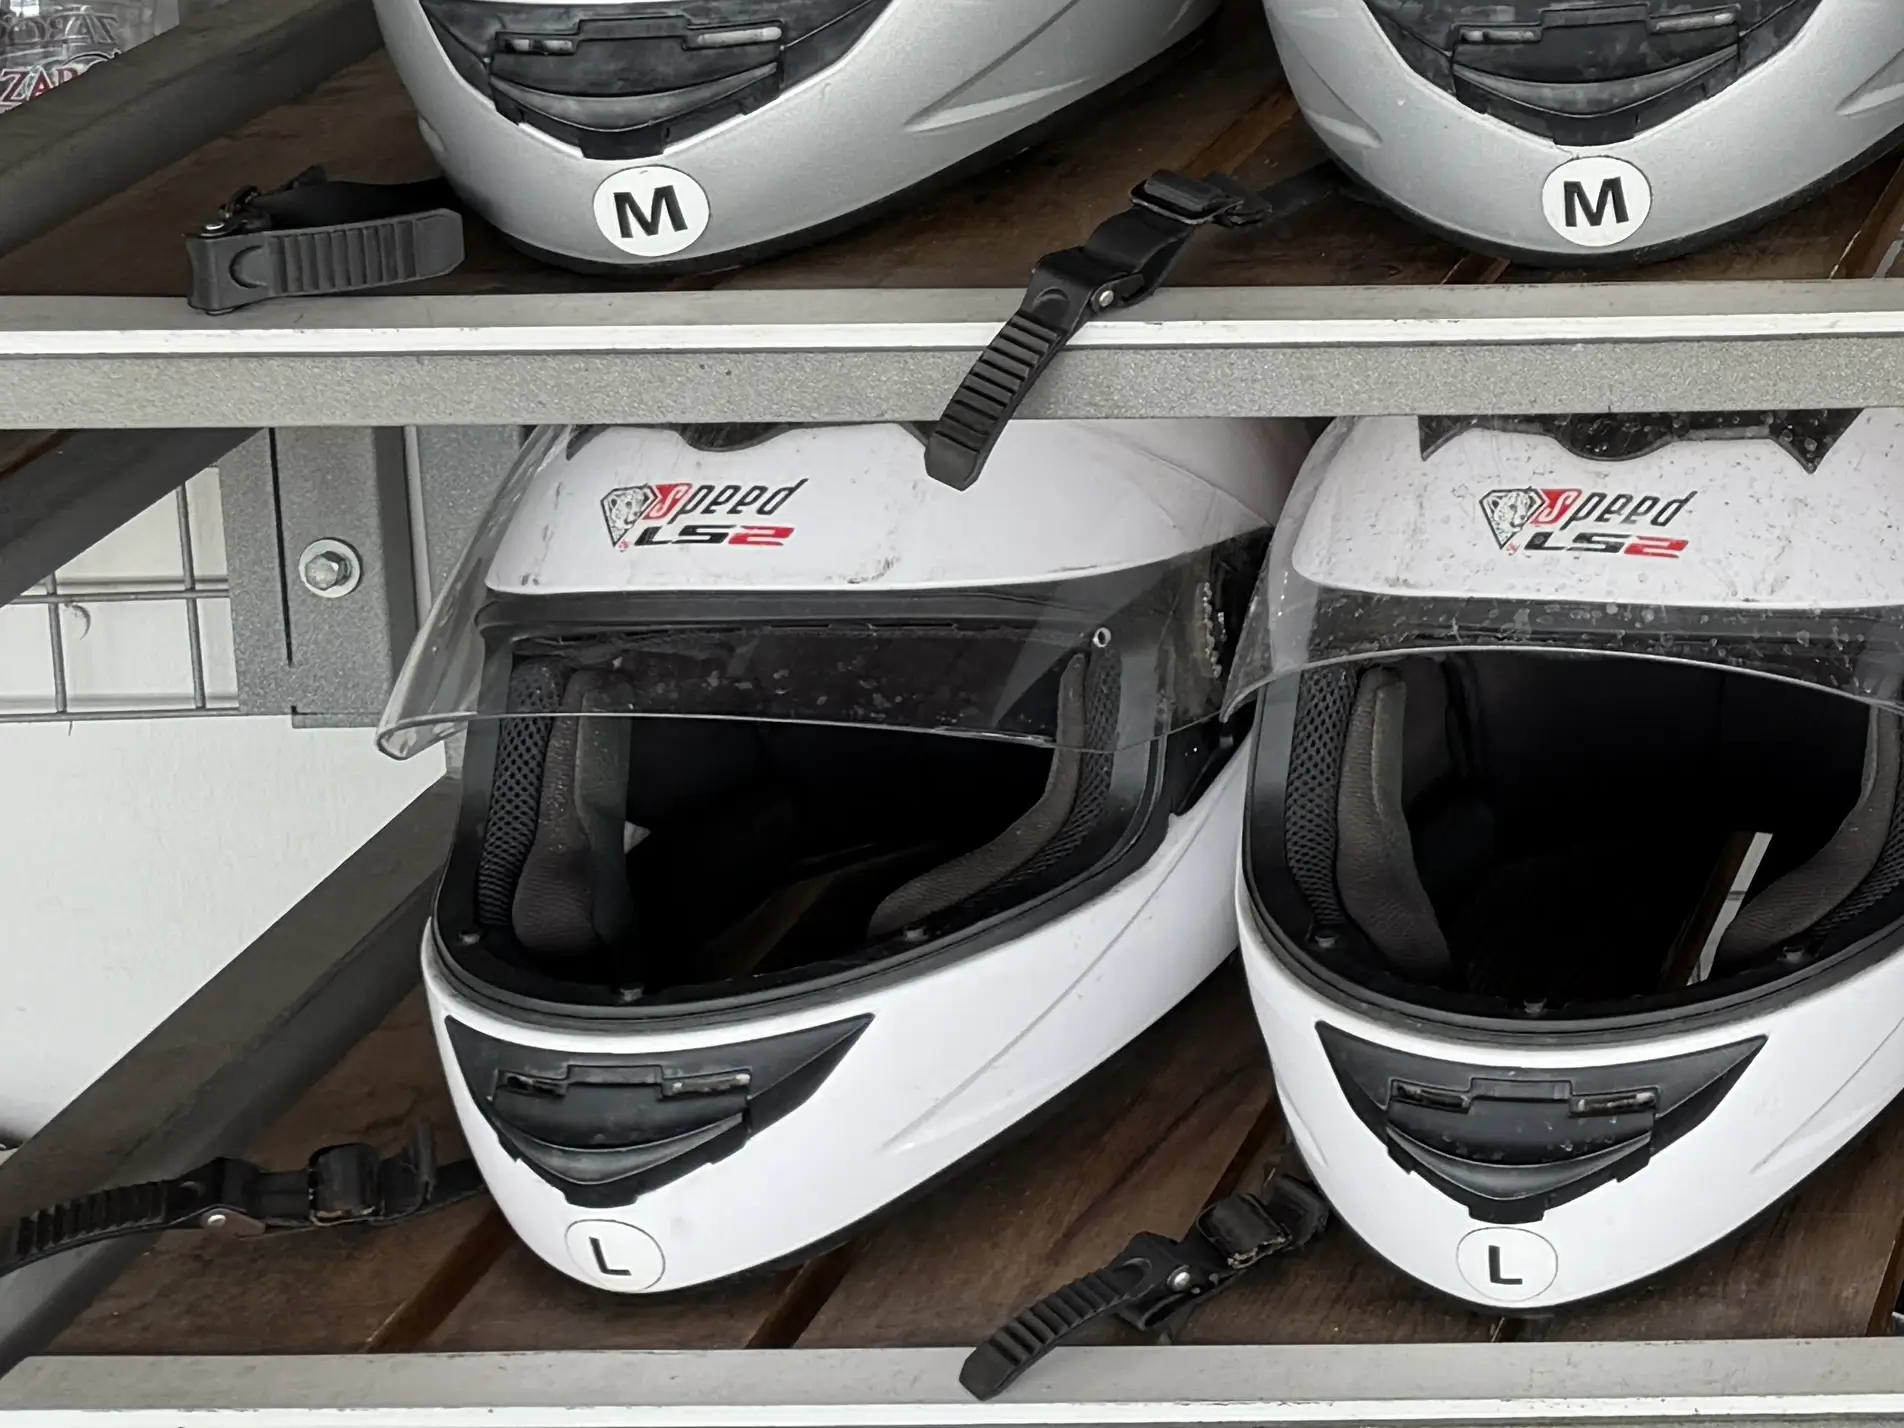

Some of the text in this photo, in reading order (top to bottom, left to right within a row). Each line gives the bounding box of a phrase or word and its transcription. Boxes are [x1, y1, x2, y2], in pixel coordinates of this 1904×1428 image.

[614, 186, 687, 238] M
[1564, 178, 1628, 226] M
[642, 478, 809, 524] Speed
[1531, 489, 1698, 531] Speed
[633, 524, 795, 547] LS2
[1523, 532, 1689, 558] LS2
[590, 1238, 630, 1275] L
[1489, 1246, 1522, 1284] L
